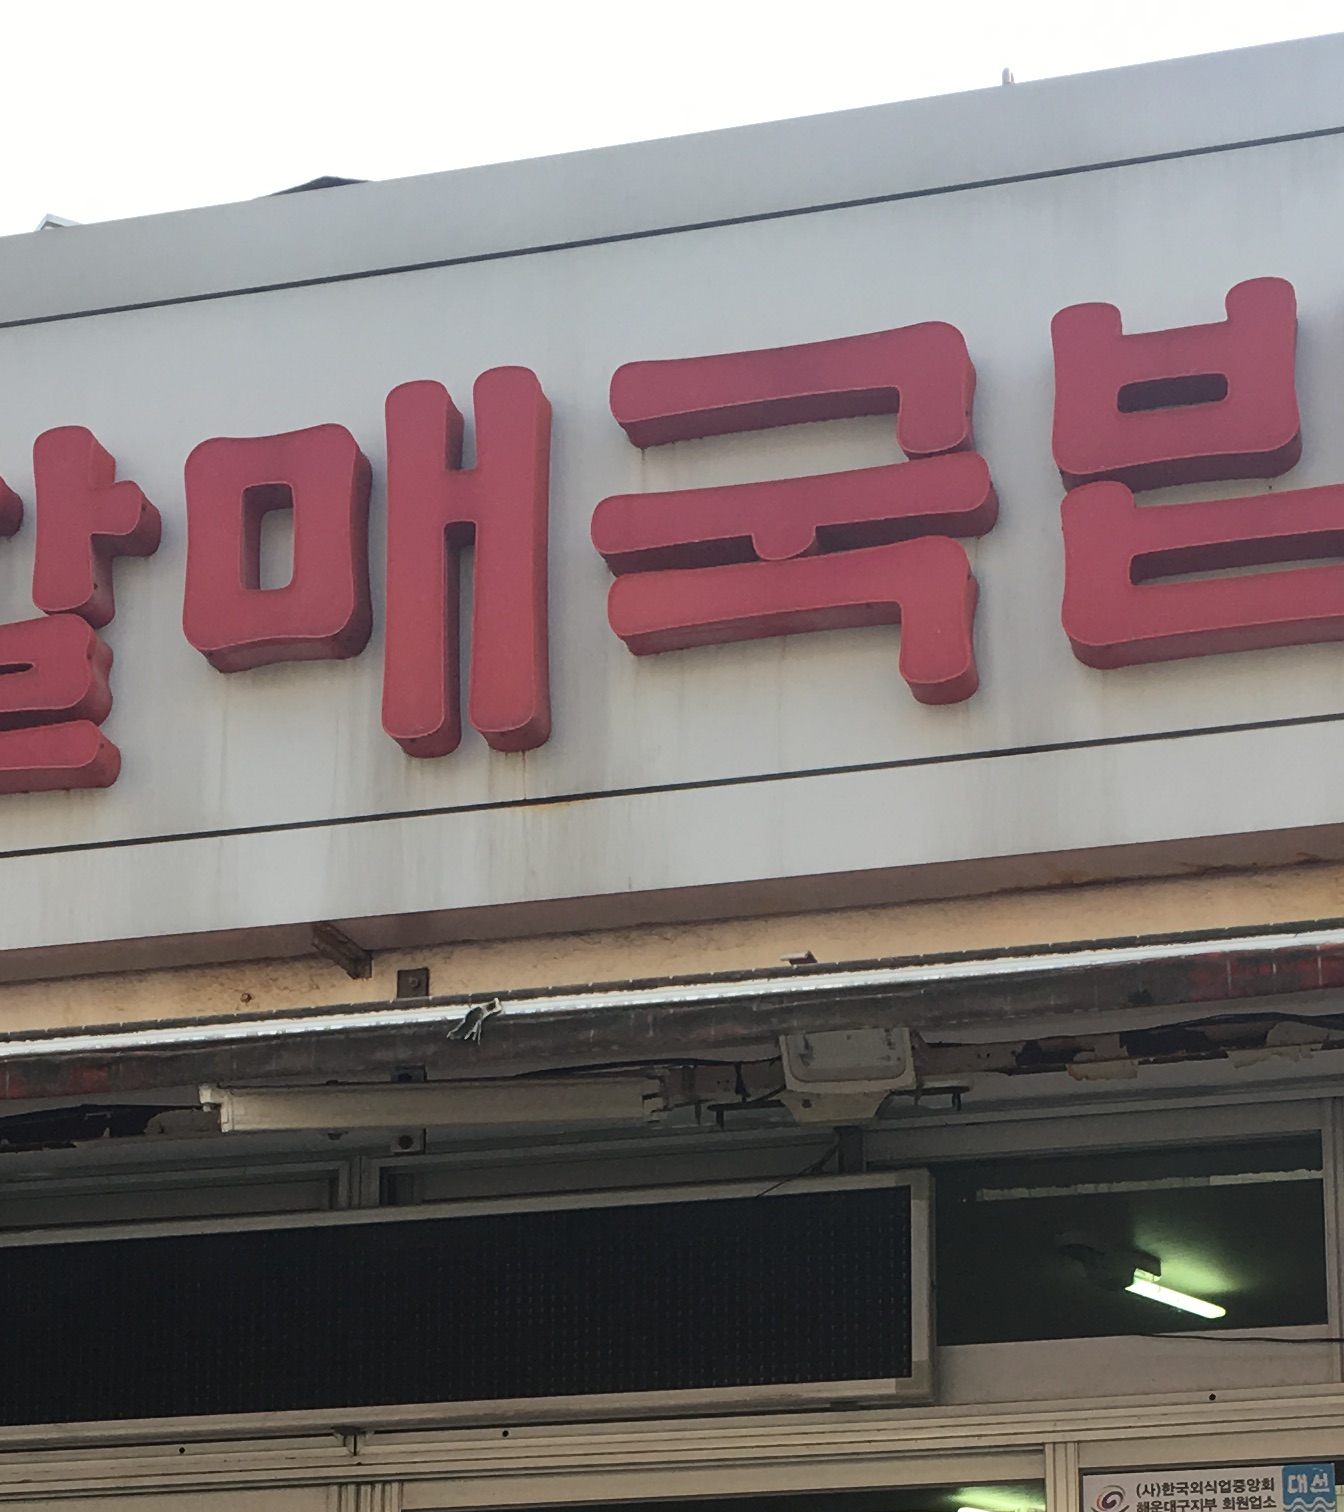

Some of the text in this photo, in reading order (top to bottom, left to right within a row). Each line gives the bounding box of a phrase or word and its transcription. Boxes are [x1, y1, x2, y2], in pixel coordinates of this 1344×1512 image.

[1136, 1478, 1275, 1498] (사)한국외식업중앙회
[1287, 1468, 1331, 1493] 대선
[1222, 1496, 1277, 1511] 회원업소
